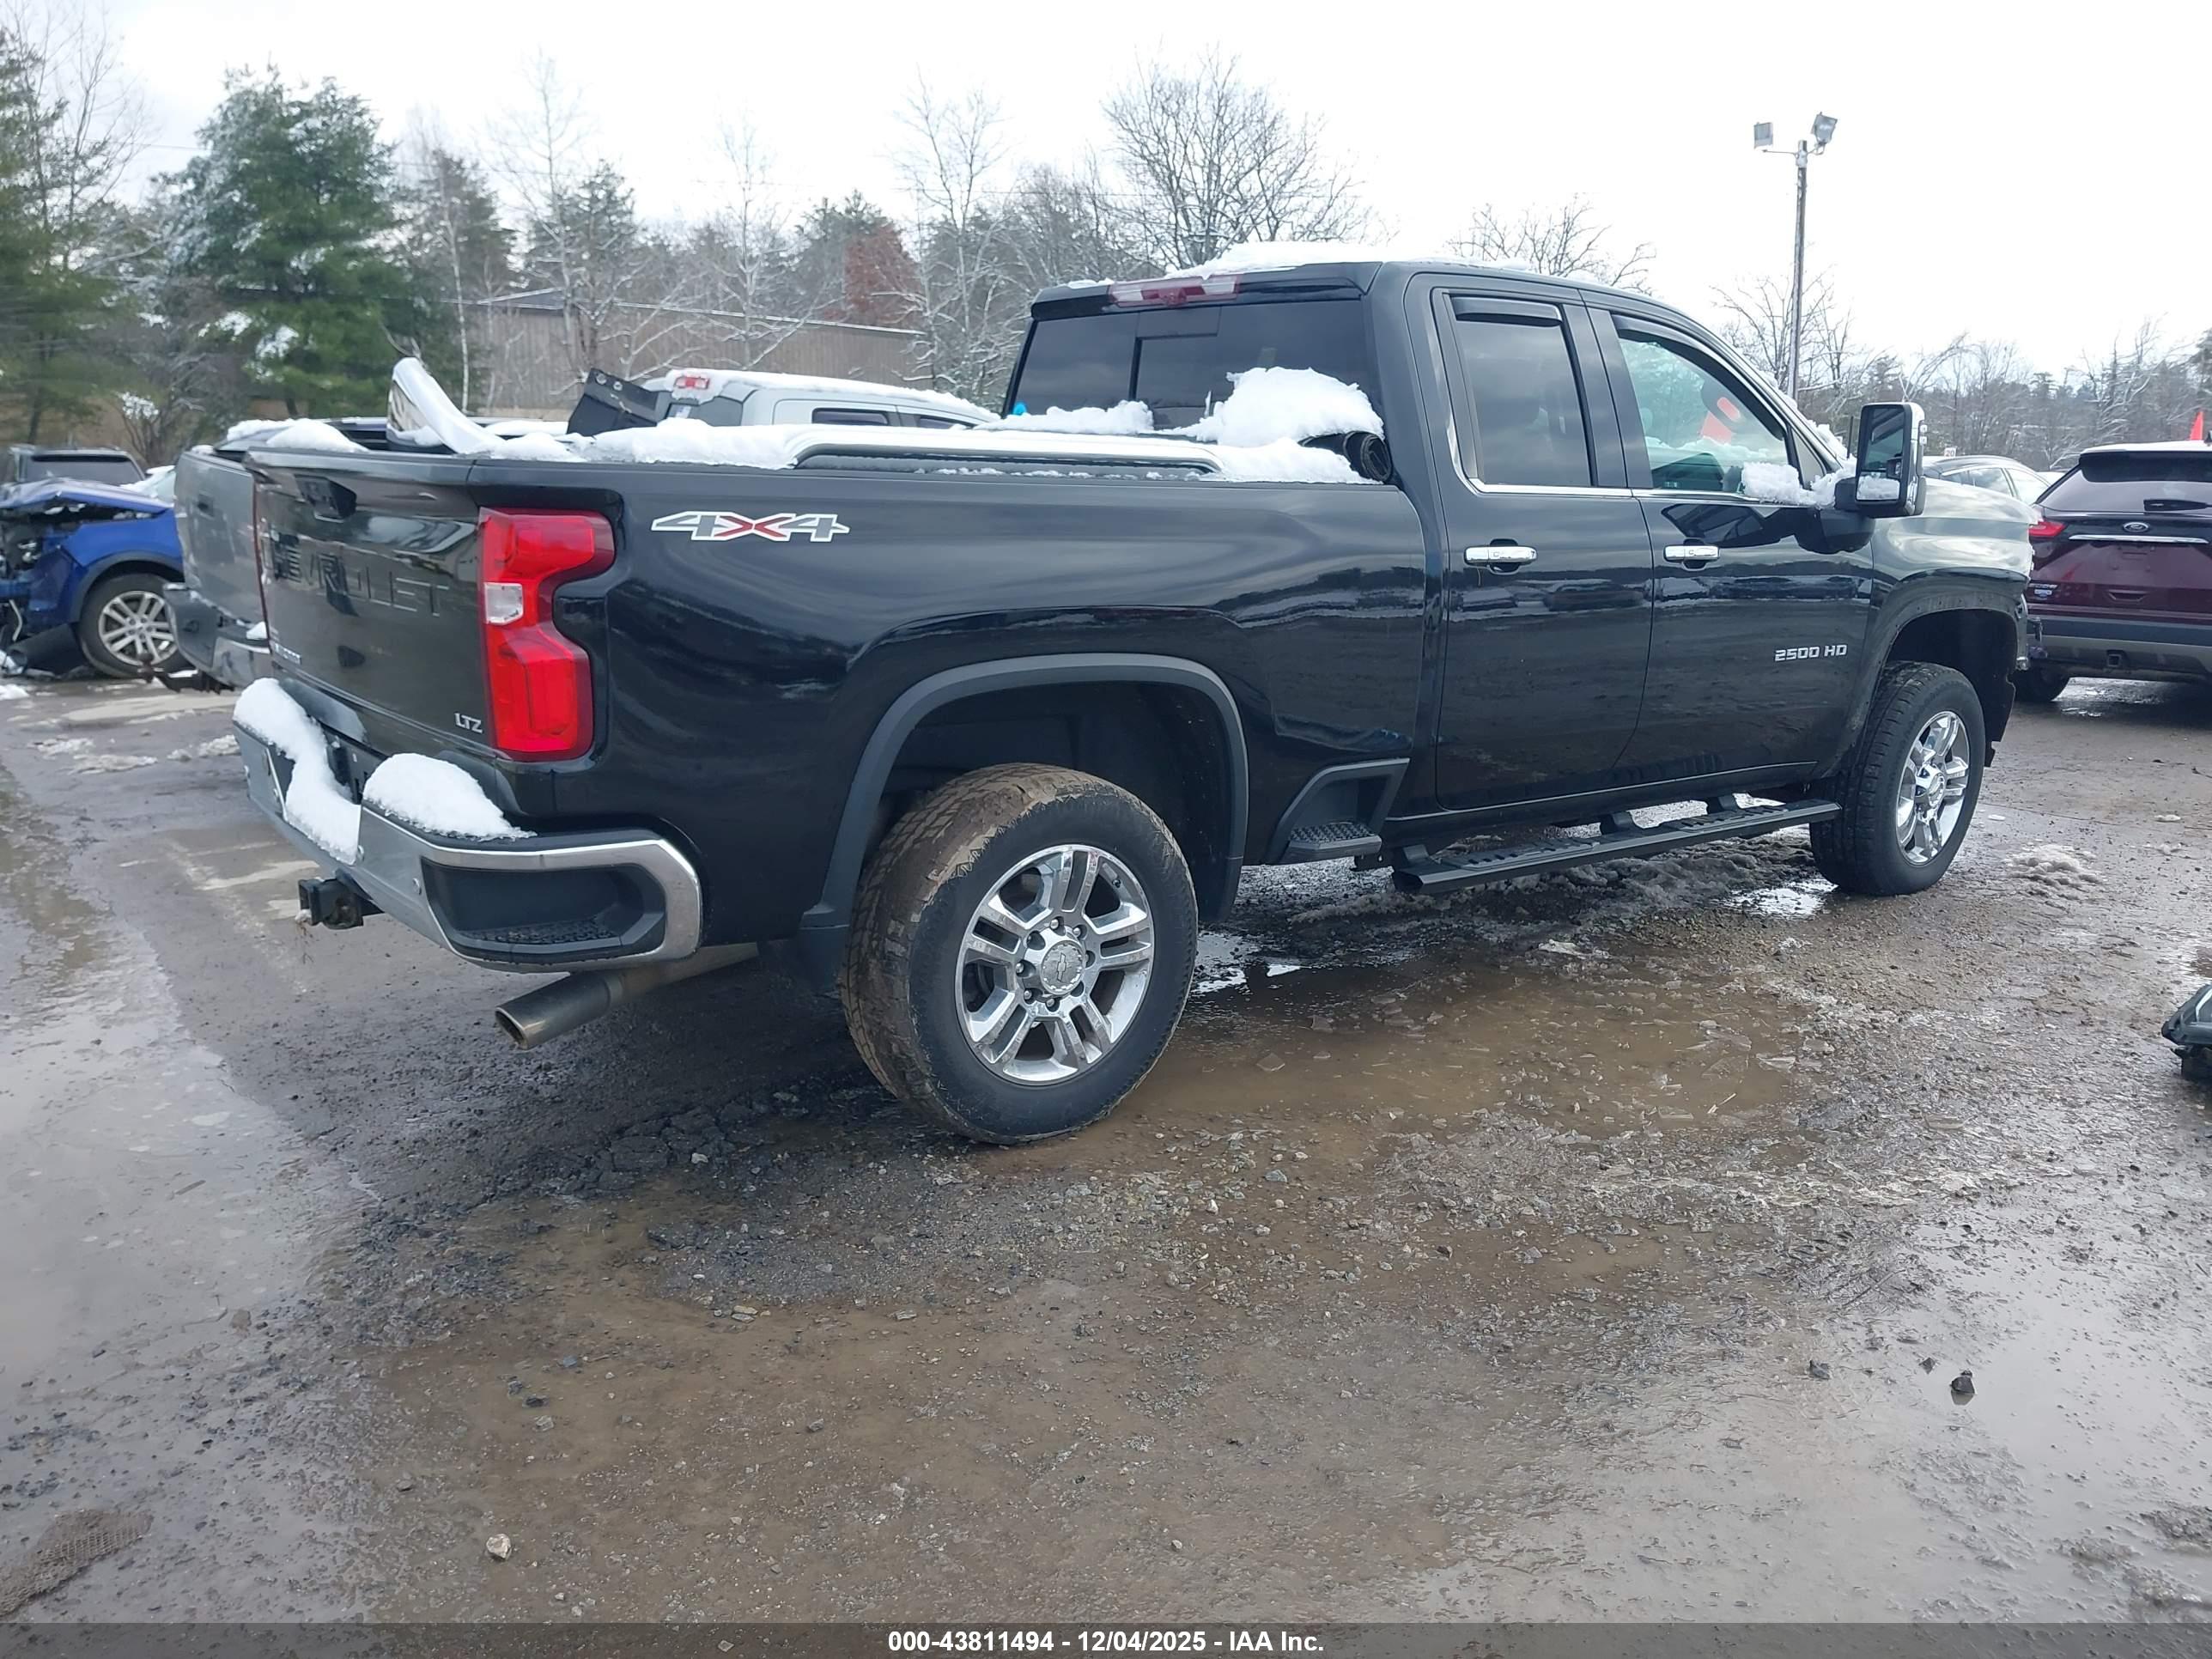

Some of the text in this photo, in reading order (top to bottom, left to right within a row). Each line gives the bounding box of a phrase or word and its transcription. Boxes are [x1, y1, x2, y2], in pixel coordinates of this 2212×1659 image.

[1774, 644, 1848, 662] 2500 HD
[454, 713, 483, 733] LTZ
